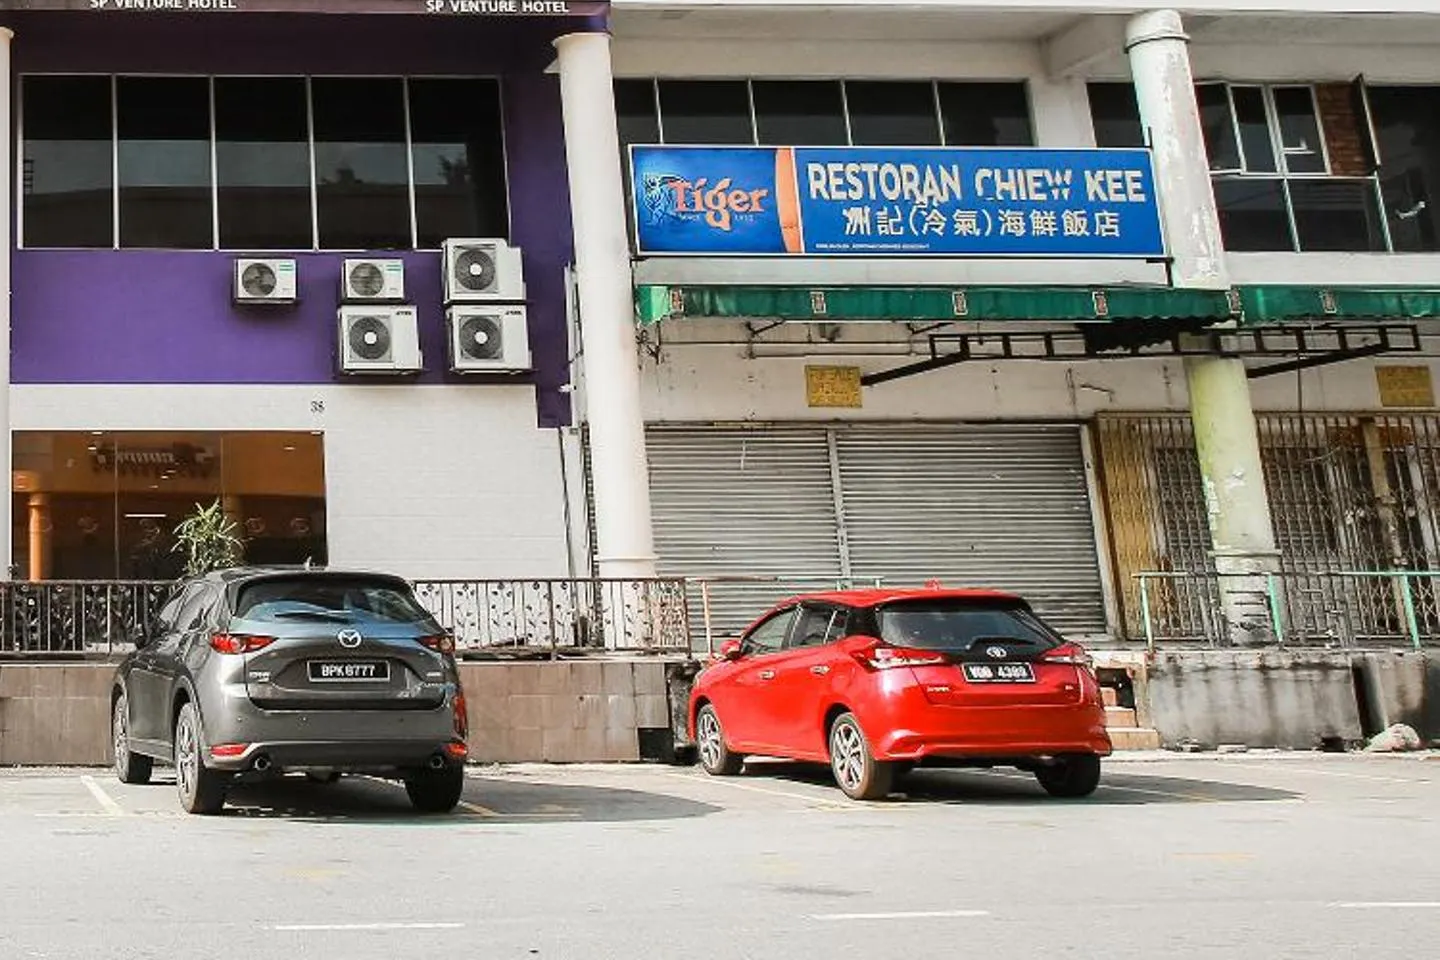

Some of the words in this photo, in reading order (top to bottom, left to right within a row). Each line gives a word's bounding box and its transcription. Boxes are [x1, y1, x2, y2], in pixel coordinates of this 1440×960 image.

[426, 0, 444, 12] SP
[449, 0, 517, 12] VENTURE
[522, 1, 569, 13] HOTEL
[808, 162, 963, 203] RESTORAN
[1084, 170, 1146, 202] KEE
[668, 178, 768, 231] Tiger
